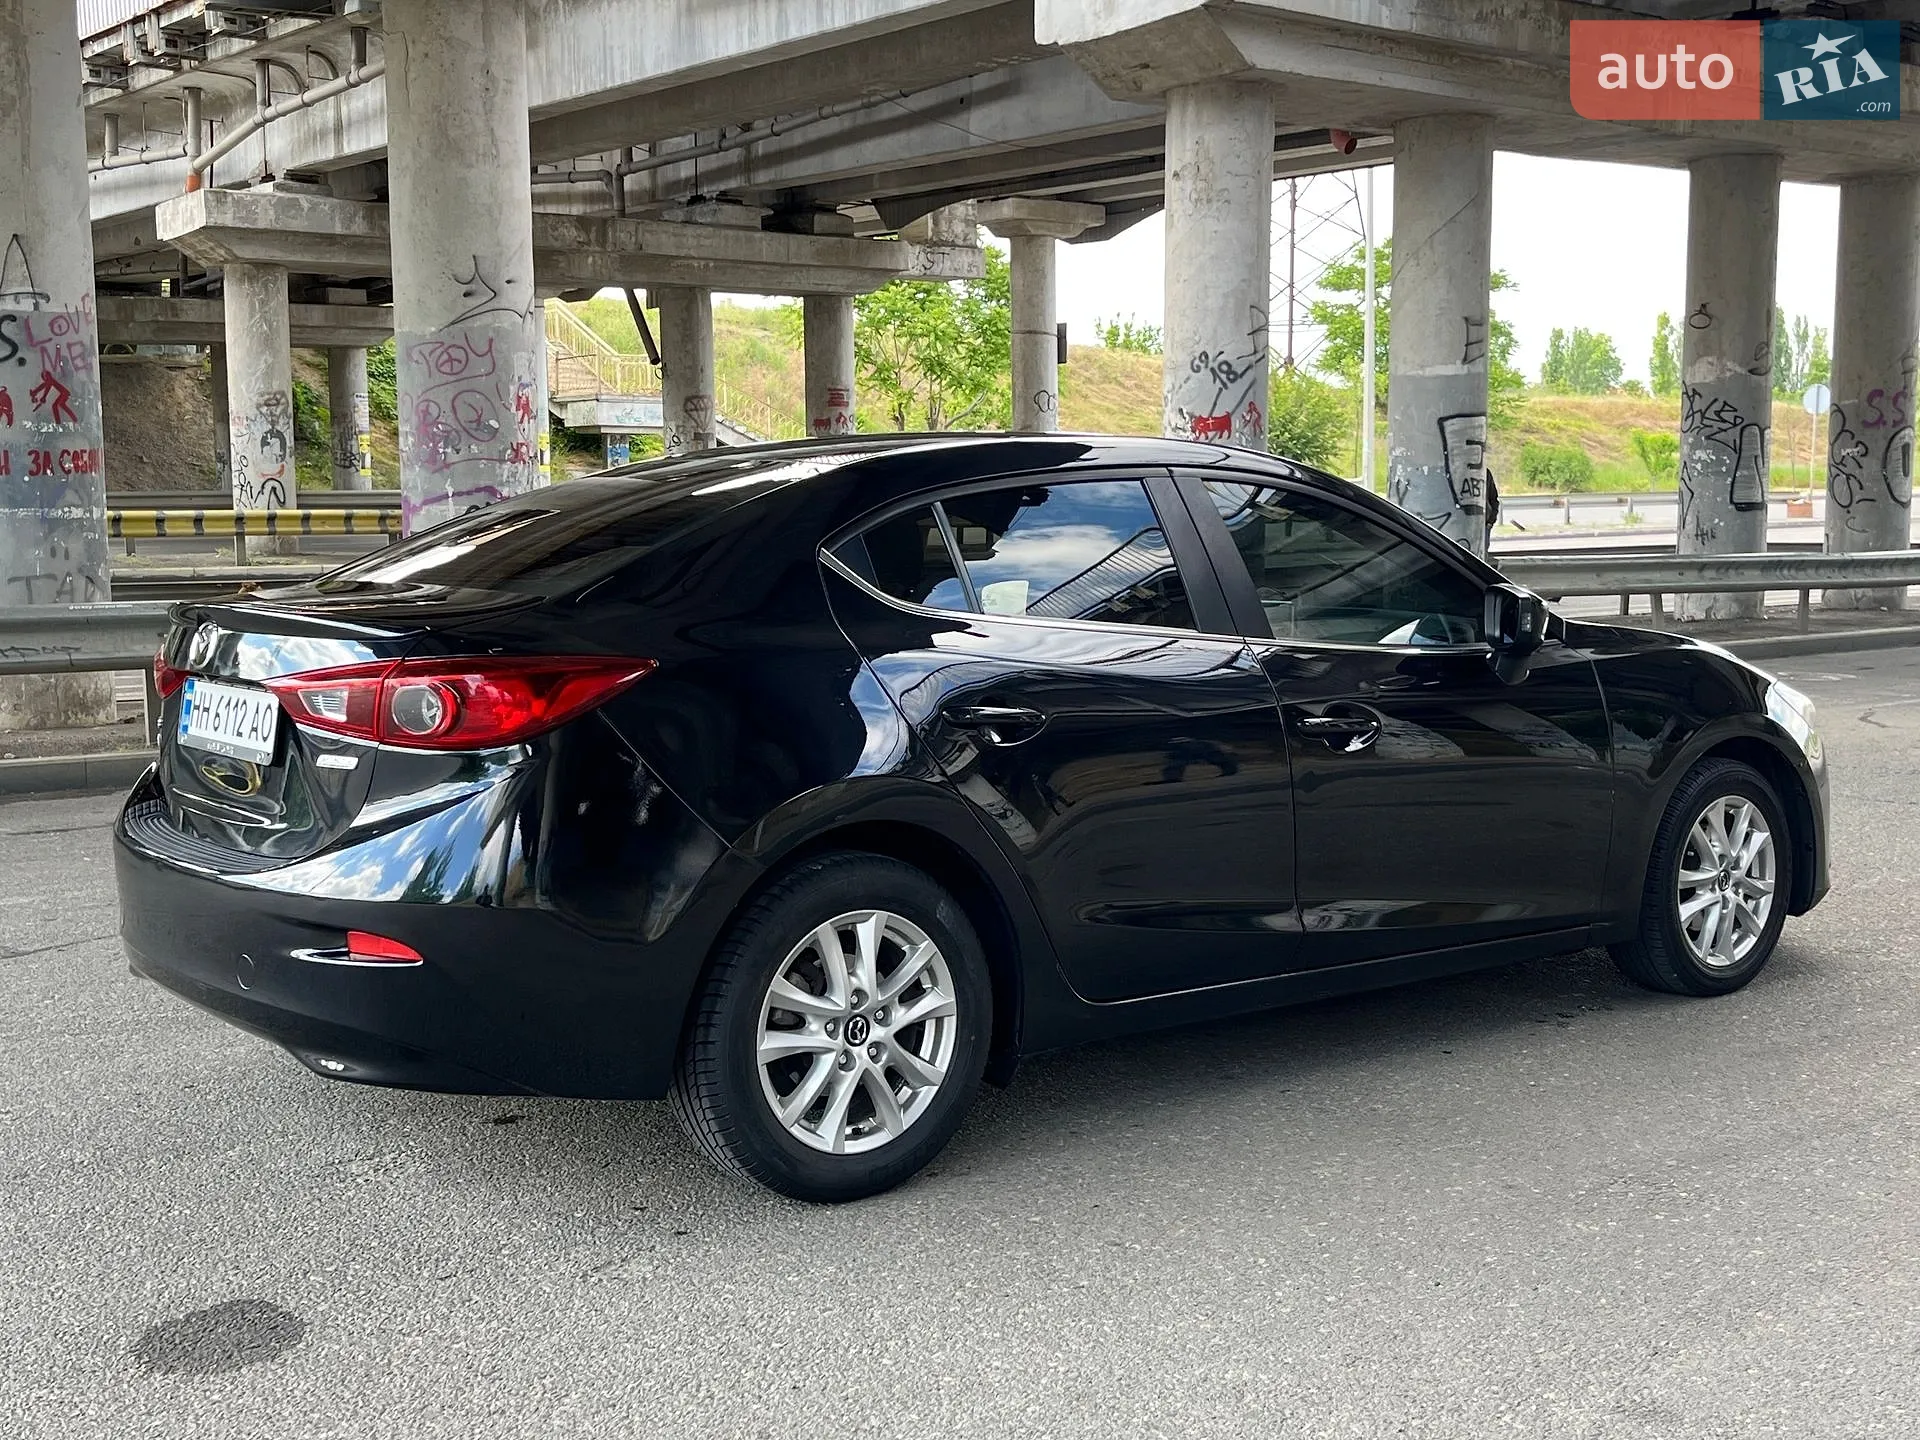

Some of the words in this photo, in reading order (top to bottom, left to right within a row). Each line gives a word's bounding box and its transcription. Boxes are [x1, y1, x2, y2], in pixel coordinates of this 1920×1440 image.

[24, 293, 93, 347] LOVE
[40, 340, 93, 378] ME
[27, 448, 55, 477] ЗА
[212, 695, 248, 738] 6112
